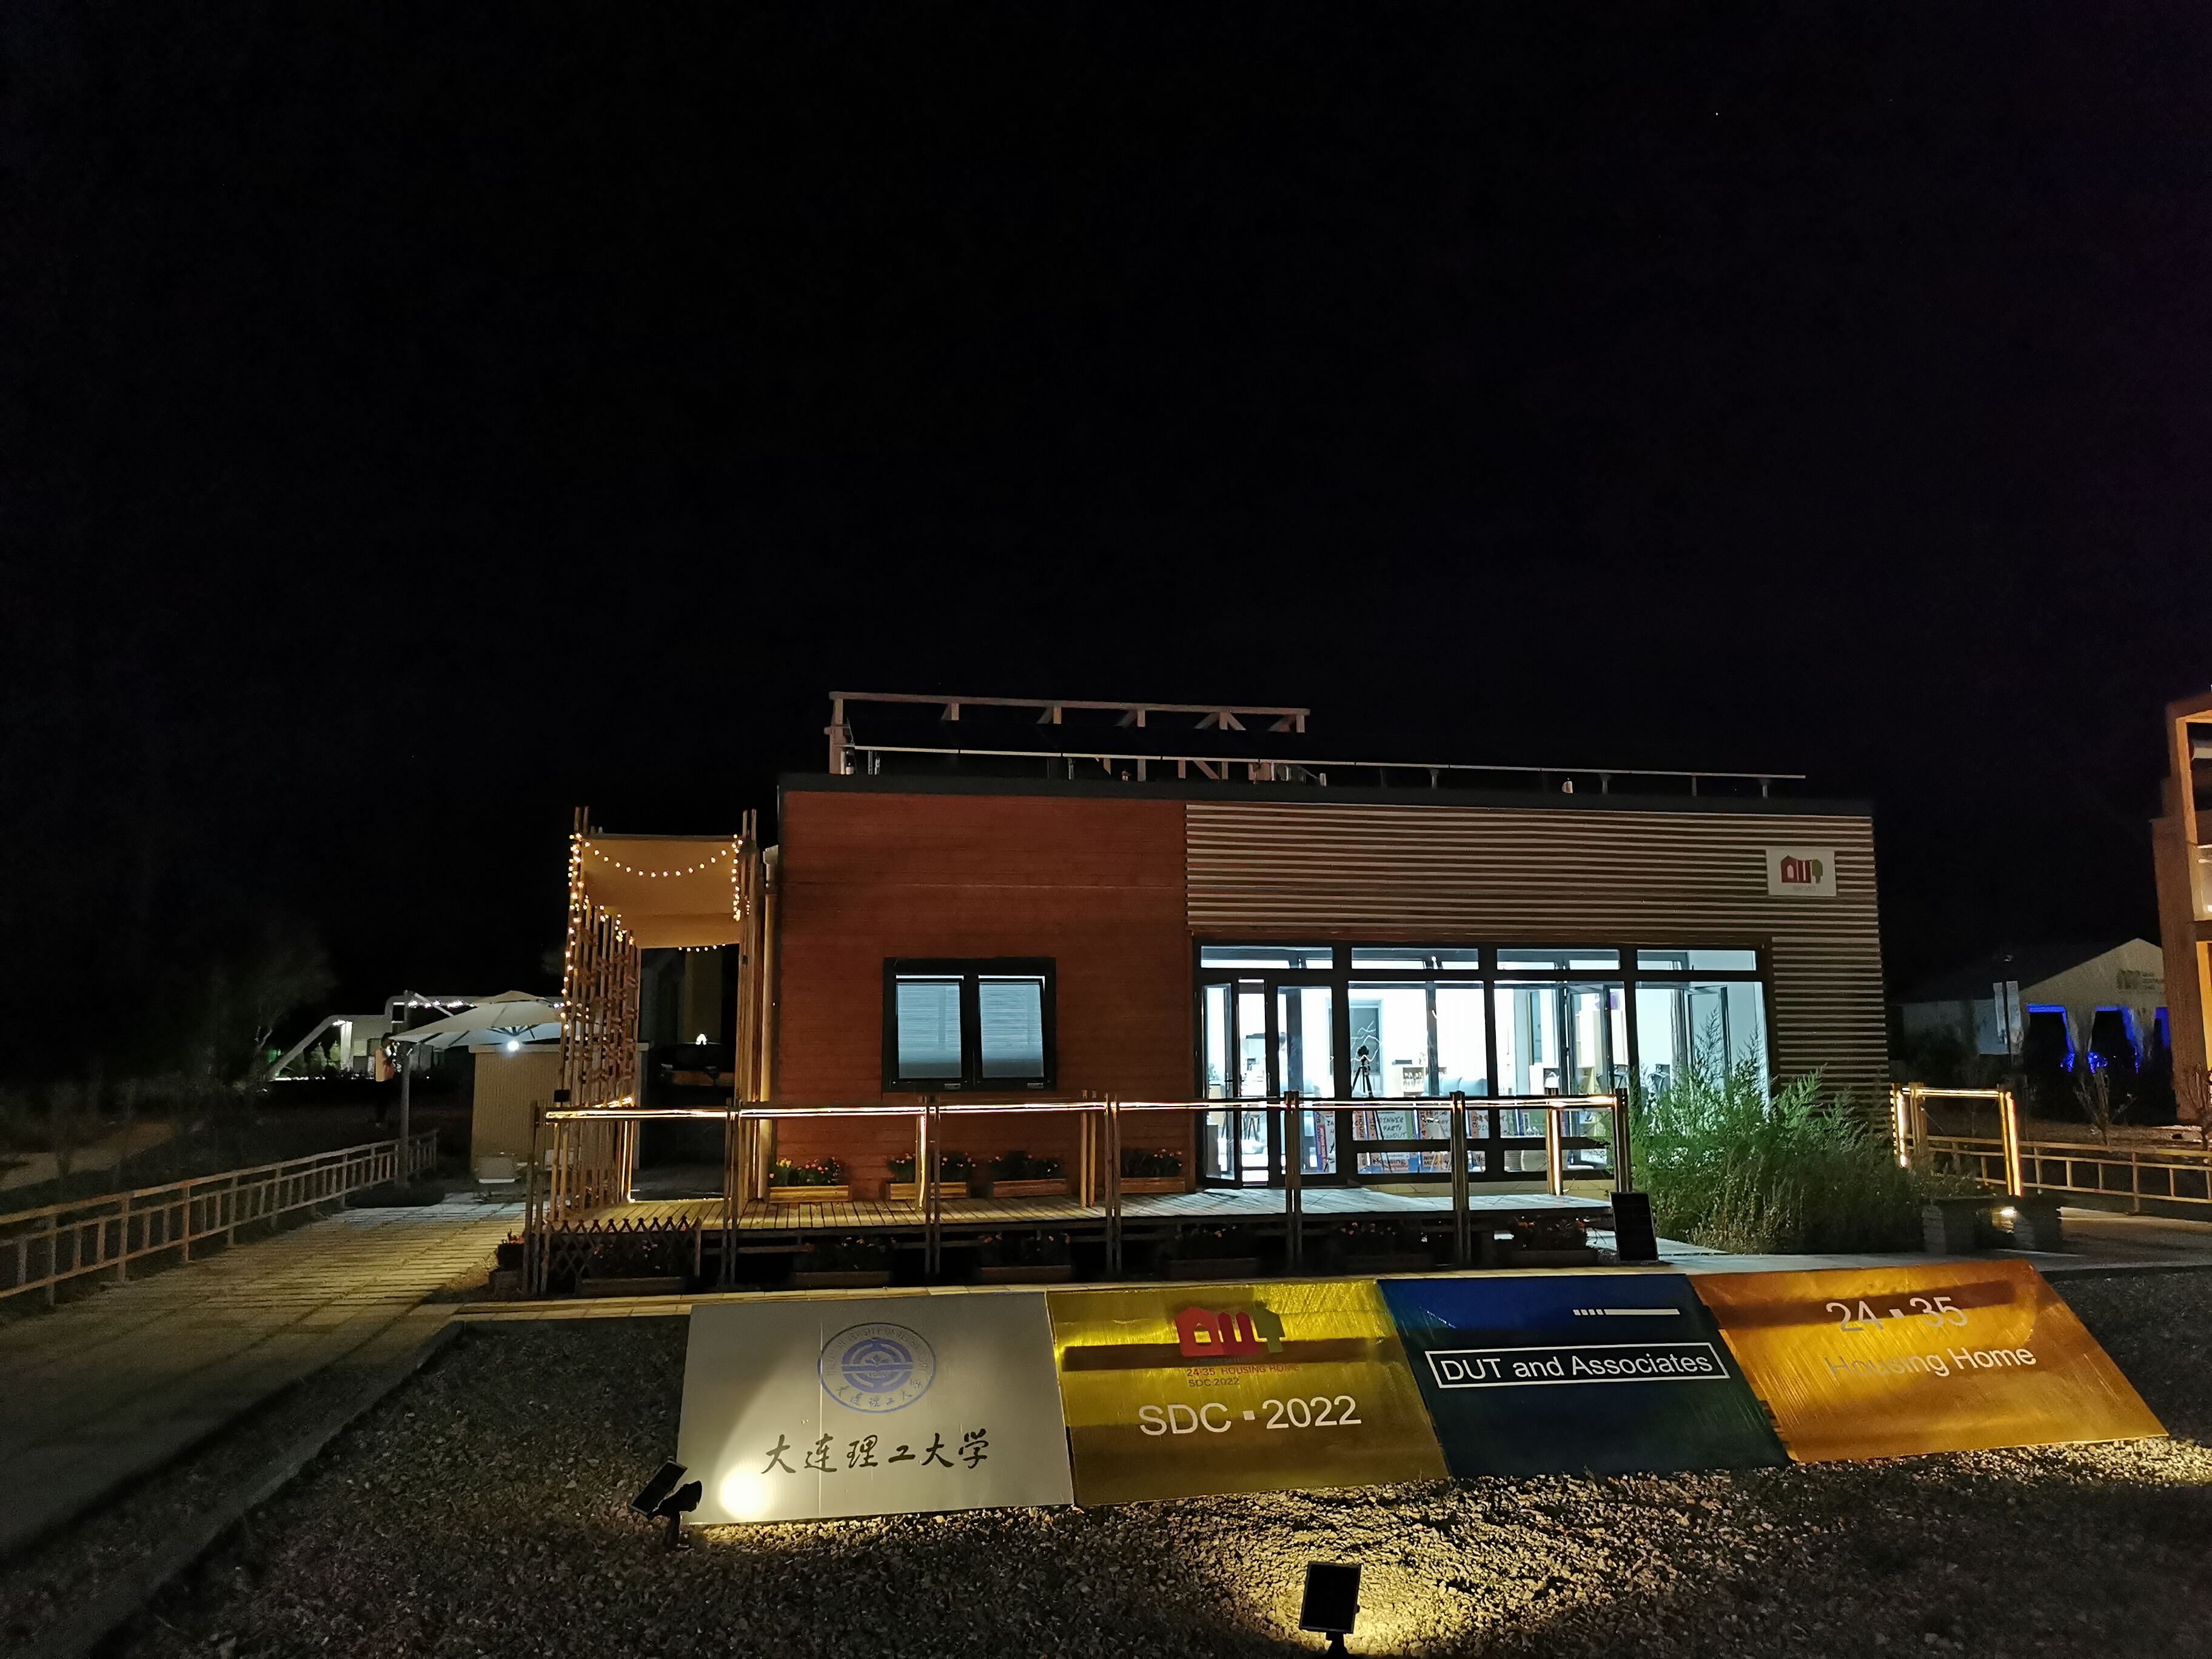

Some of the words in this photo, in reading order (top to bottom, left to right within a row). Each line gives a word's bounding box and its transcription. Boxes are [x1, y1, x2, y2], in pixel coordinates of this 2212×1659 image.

[1825, 1299, 1885, 1333] 24
[1909, 1296, 1968, 1328] 35
[1439, 1358, 1501, 1380] DUT
[1512, 1356, 1564, 1377] and
[1572, 1353, 1713, 1376] Associates
[1824, 1353, 1950, 1378] Housing
[1947, 1347, 2037, 1370] Home
[1138, 1403, 1232, 1436] SDC
[1261, 1395, 1362, 1430] 2022
[760, 1427, 990, 1475] 大连理工大学
